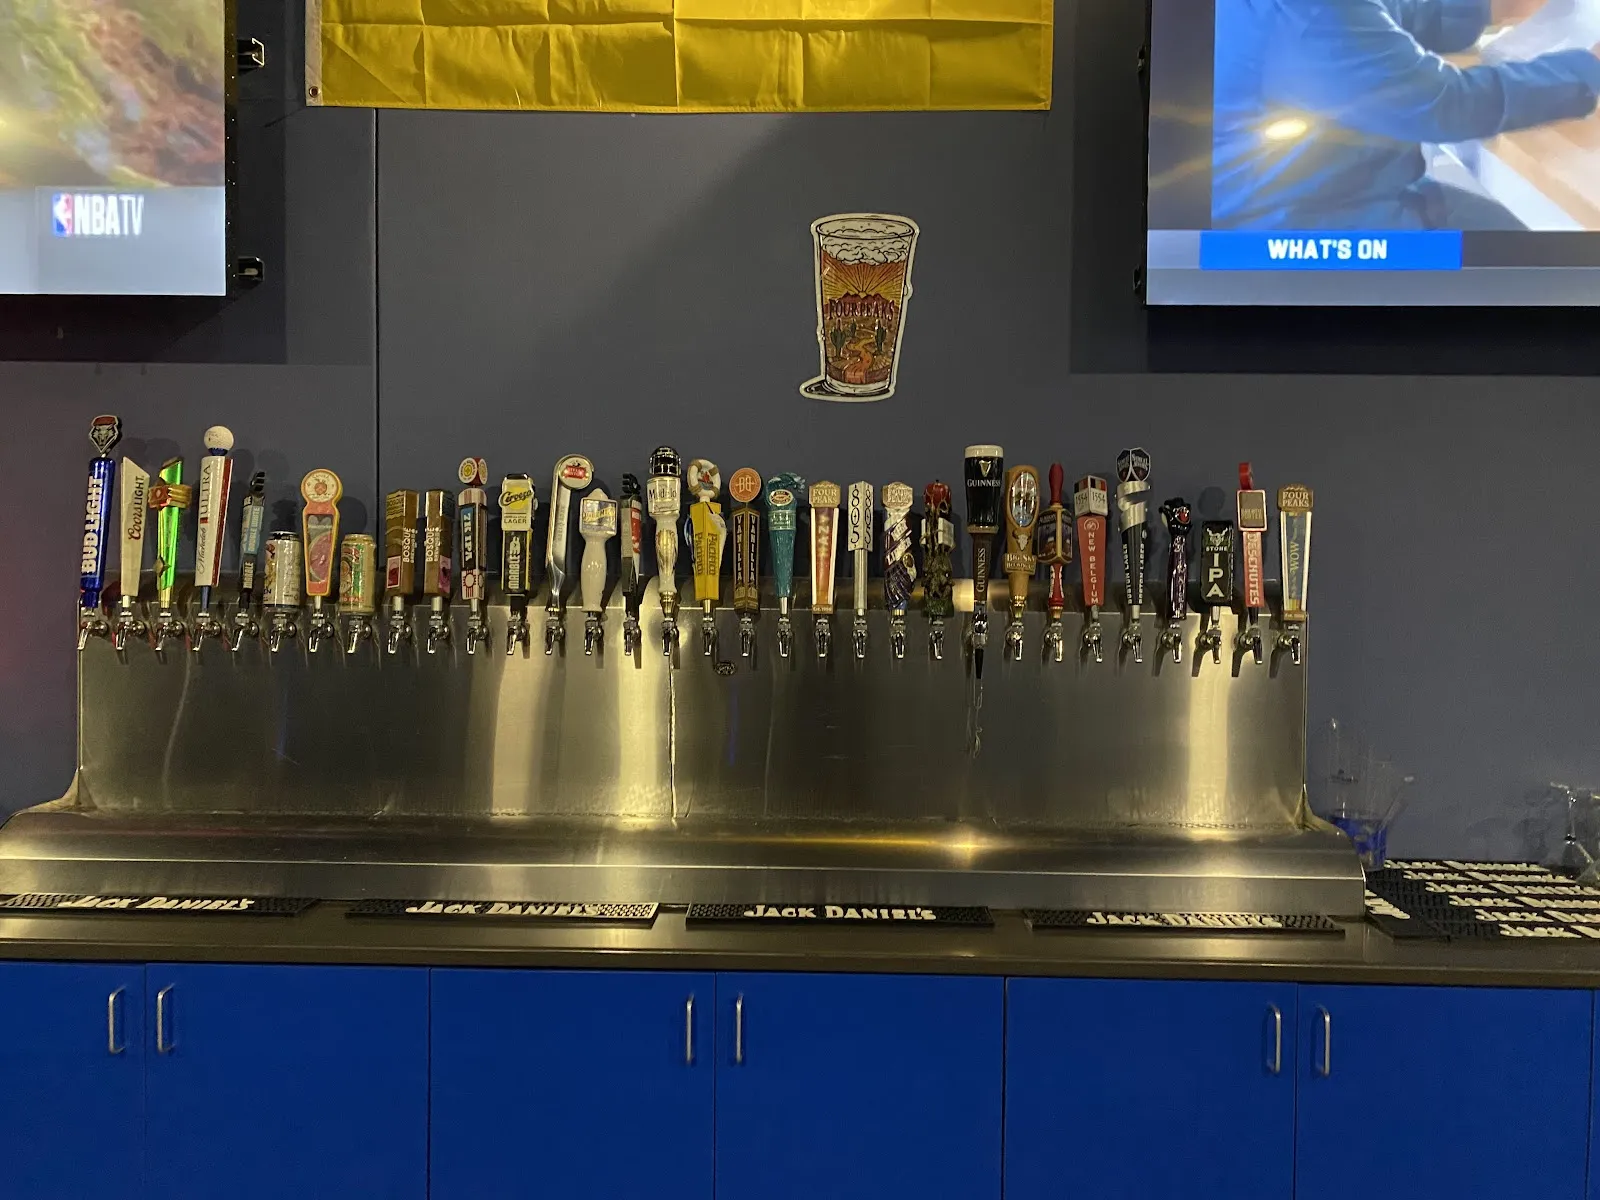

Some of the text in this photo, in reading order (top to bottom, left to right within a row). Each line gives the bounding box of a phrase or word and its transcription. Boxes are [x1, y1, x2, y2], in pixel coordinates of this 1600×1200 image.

[1267, 239, 1388, 260] WHAT'S ON
[828, 299, 895, 321] FOUR PEAKS
[500, 489, 532, 506] Cerveza
[812, 489, 837, 497] FOUR
[966, 479, 1001, 488] GUINNESS
[1282, 491, 1309, 500] FOUR
[128, 475, 145, 541] Coors LIGHT
[1282, 499, 1310, 508] PEAKS
[81, 475, 103, 574] BUD LIGHT
[196, 464, 212, 575] Michelob ULTRA
[402, 527, 411, 563] BOSQUE
[426, 527, 435, 562] BOSQUE
[463, 512, 473, 562] 7K IPA
[975, 547, 986, 593] GUINNESS
[1087, 532, 1099, 604] NEW BELGIUM
[1122, 543, 1130, 571] LAGER
[1247, 533, 1260, 605] DESCHUTES
[243, 561, 254, 589] MARBLE
[508, 554, 520, 590] MARBLE
[1206, 553, 1225, 598] IPA
[404, 901, 482, 914] JACK
[744, 904, 936, 920] JACK DANIEL'S
[1086, 911, 1161, 926] JACK
